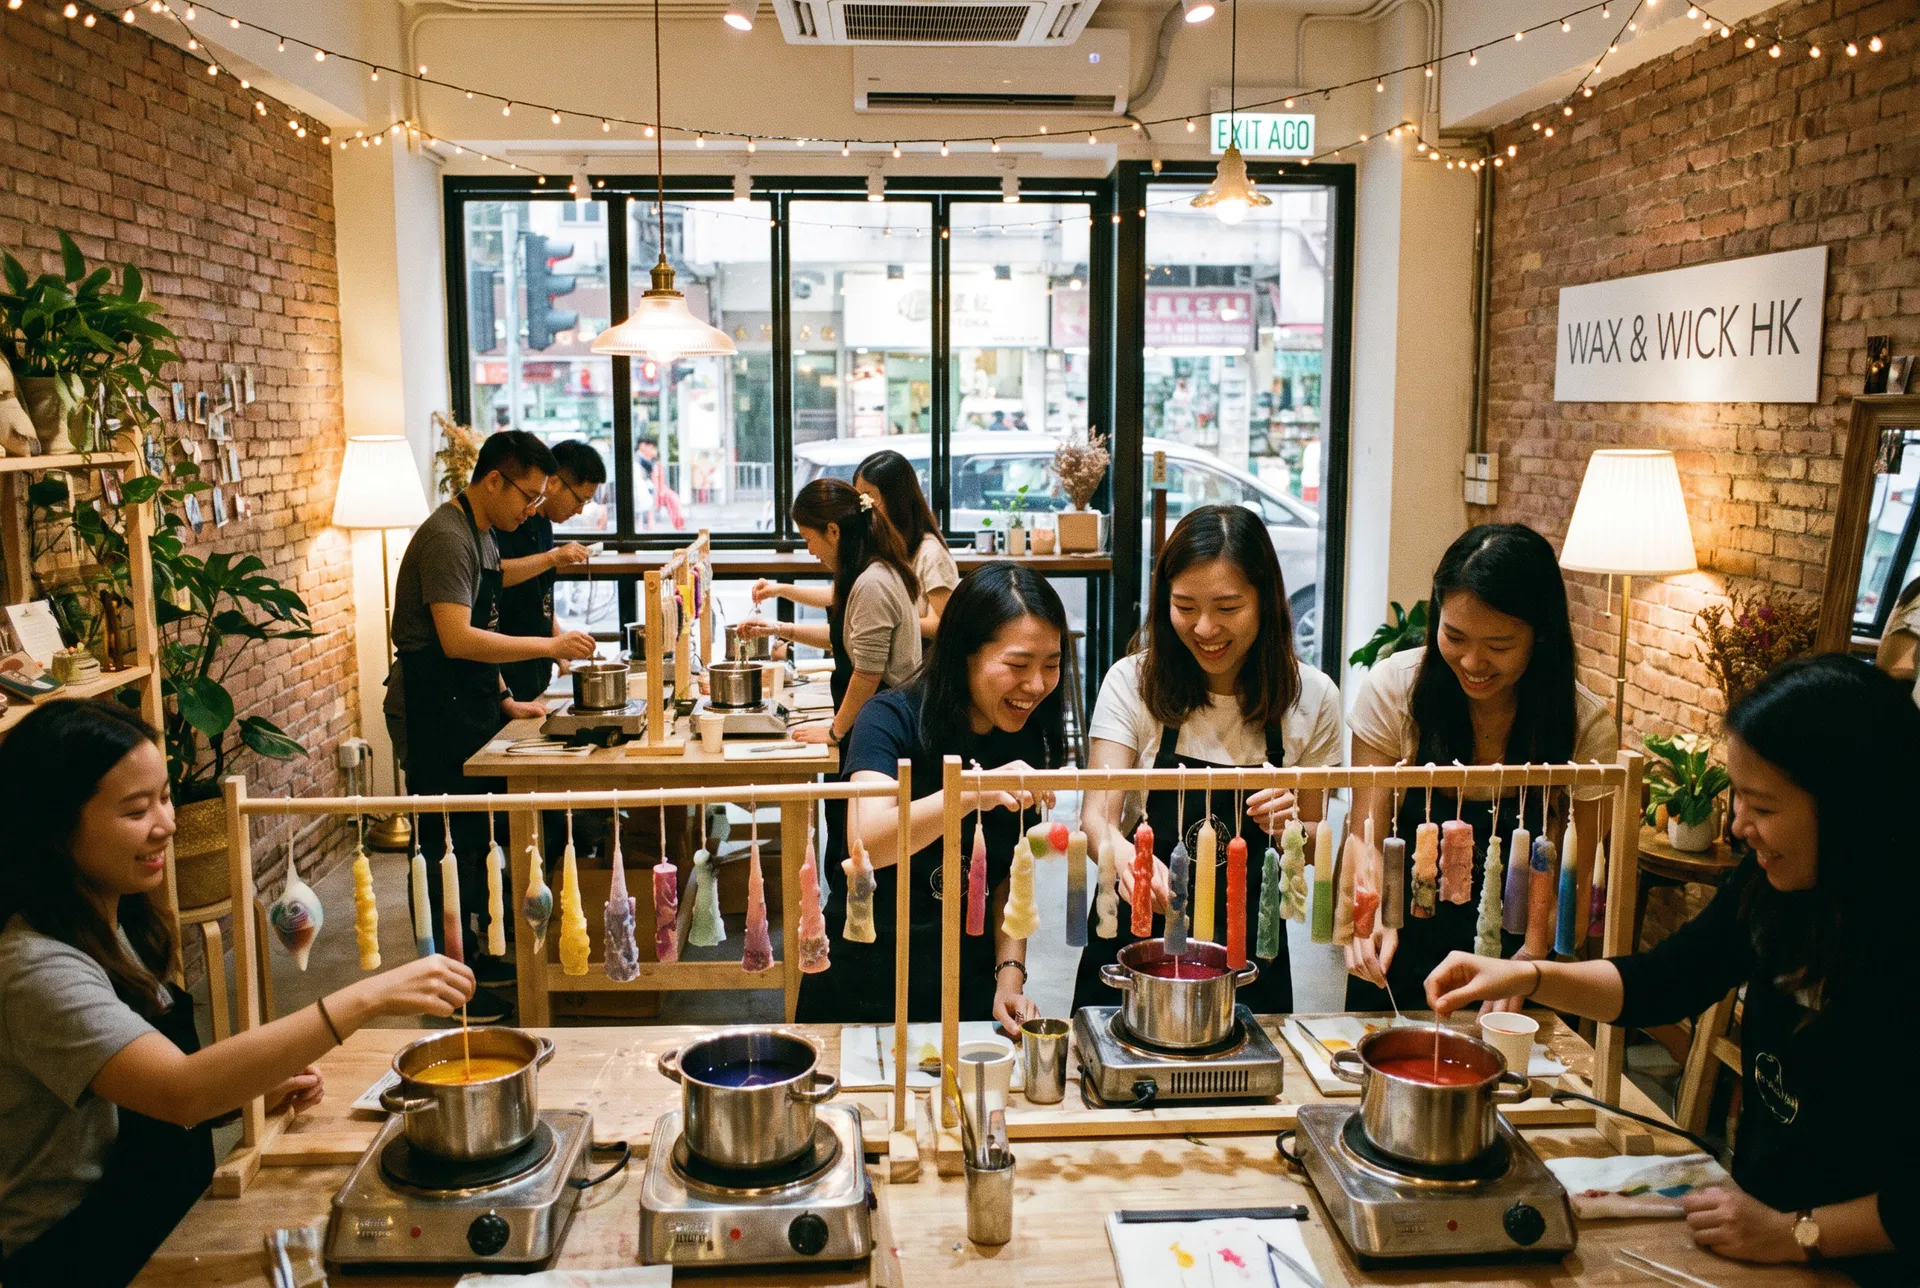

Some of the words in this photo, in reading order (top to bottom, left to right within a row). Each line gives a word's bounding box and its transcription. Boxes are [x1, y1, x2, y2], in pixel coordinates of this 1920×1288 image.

[1218, 119, 1261, 149] EXIT
[1268, 120, 1310, 150] AGO
[1568, 317, 1623, 365] WAX
[1630, 314, 1648, 363] &
[1657, 304, 1740, 361] WICK
[1750, 297, 1803, 357] HK
